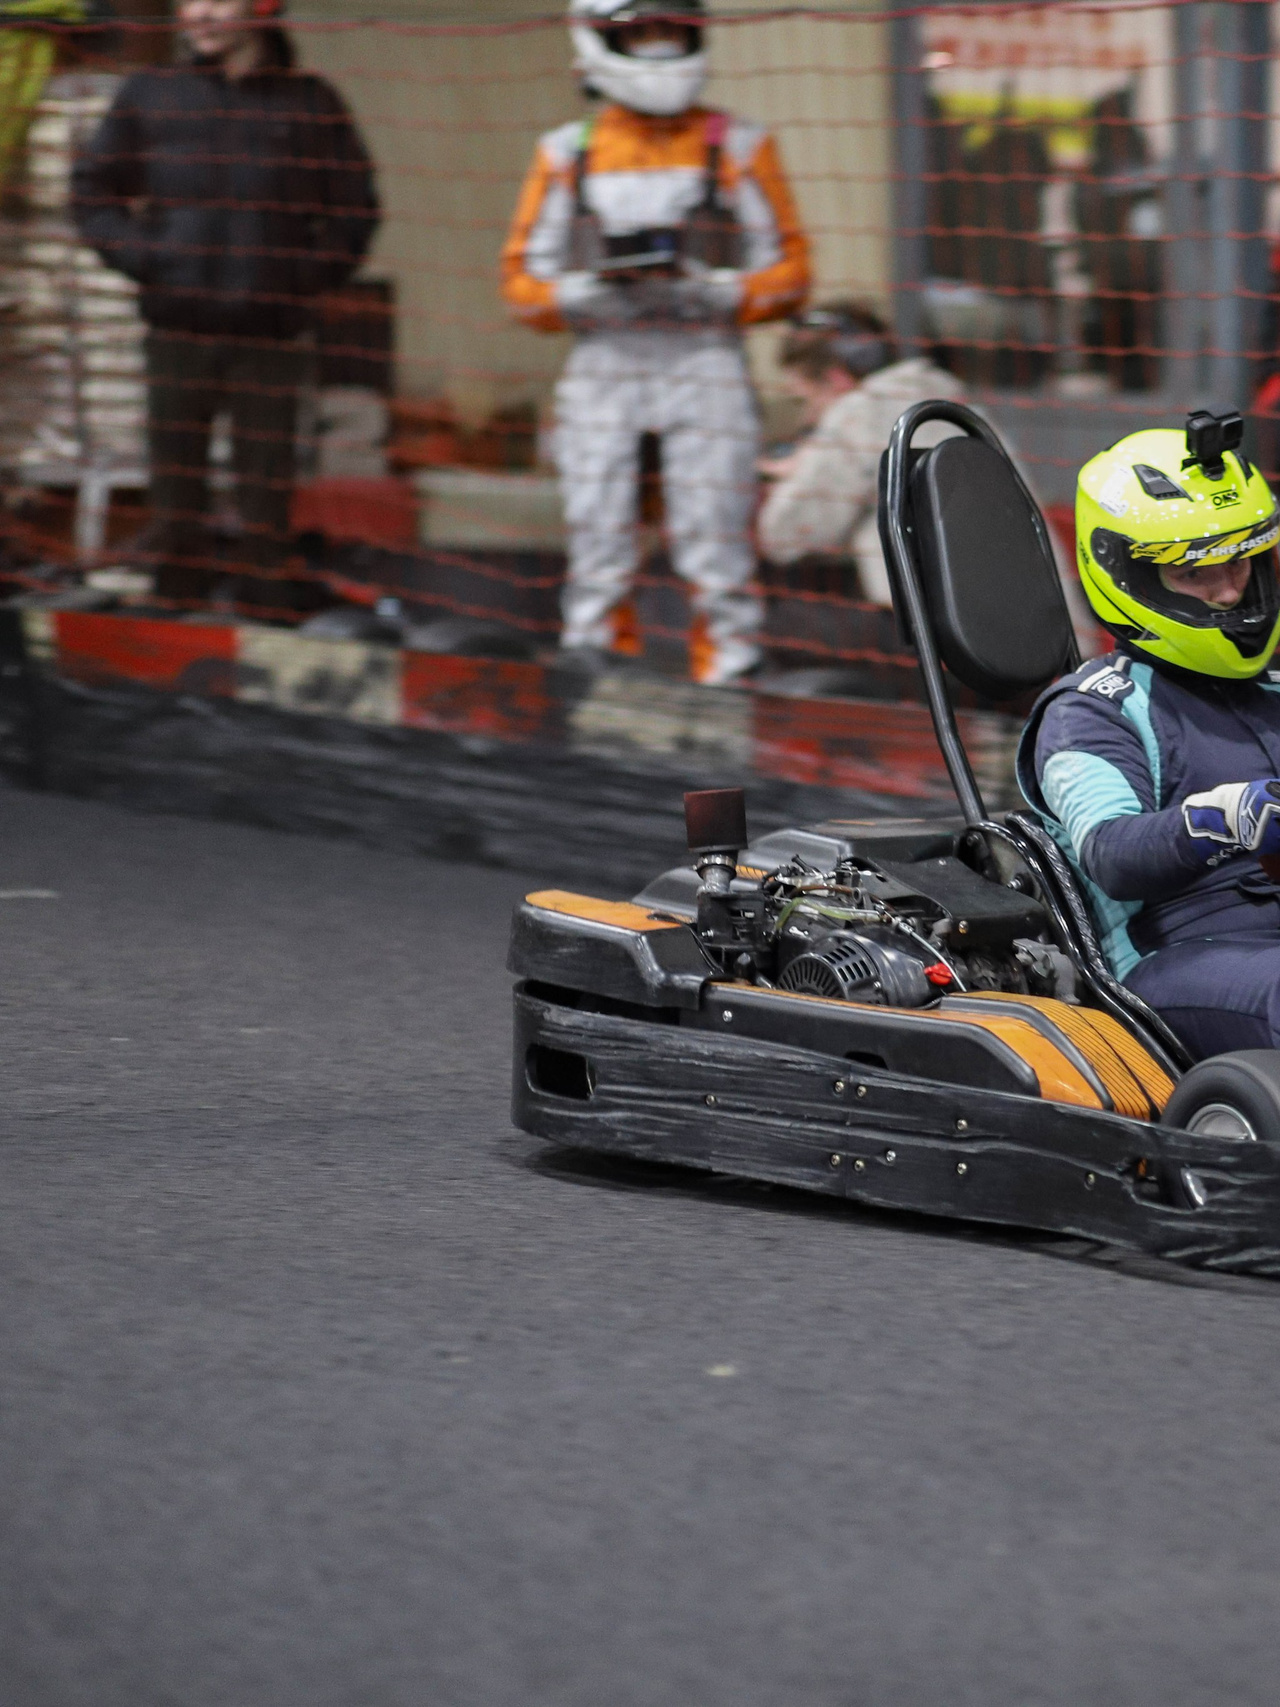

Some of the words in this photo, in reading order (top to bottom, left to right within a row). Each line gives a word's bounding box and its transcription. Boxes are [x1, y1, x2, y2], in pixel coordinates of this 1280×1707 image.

[1184, 549, 1208, 560] BE
[1210, 544, 1238, 558] THE
[1096, 675, 1126, 695] OMP
